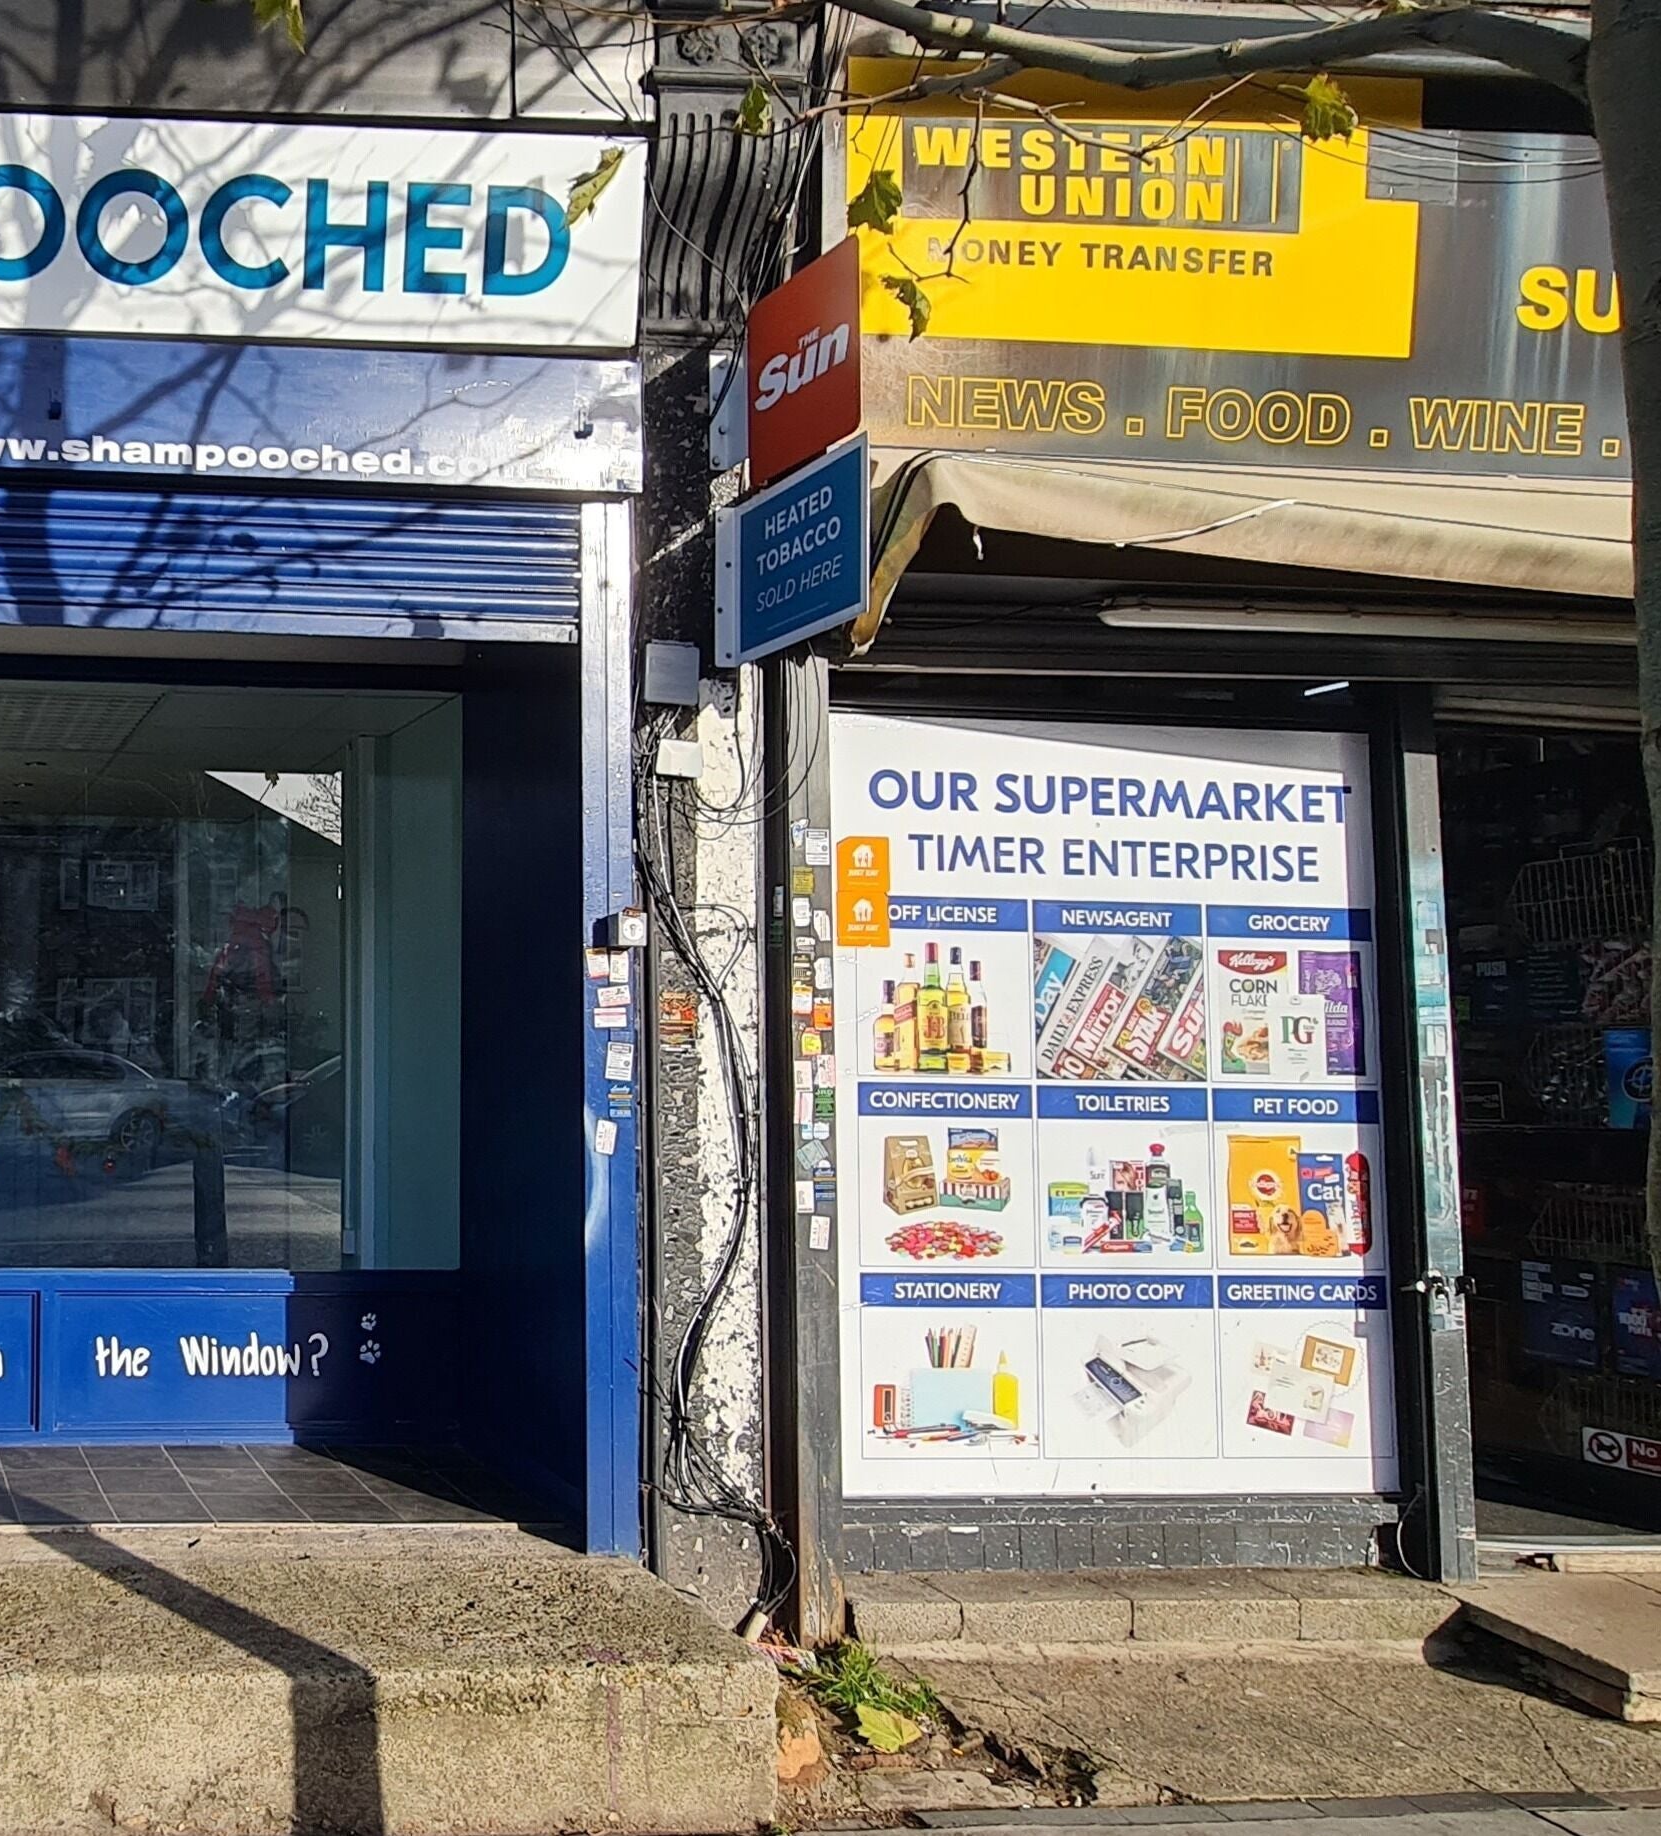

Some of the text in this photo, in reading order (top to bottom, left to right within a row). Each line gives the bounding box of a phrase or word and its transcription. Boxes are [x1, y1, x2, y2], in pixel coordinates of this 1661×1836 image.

[913, 125, 1226, 176] WESTERN
[1019, 174, 1225, 223] UNION
[927, 236, 1273, 277] MONEY TRANSFER
[797, 326, 820, 352] THE
[754, 321, 850, 412] Sun
[906, 374, 1107, 434] NEWS
[1166, 386, 1352, 447] FOOD
[1409, 396, 1586, 457] WINE
[764, 485, 833, 541] HEATED
[756, 515, 841, 576] TOBACCO
[756, 554, 843, 613] SOLD HERE
[869, 769, 1353, 824] OUR SUPERMARKET
[908, 833, 1321, 883] TIMER ENTERPRISE
[888, 903, 997, 924] OFF LICENSE
[1061, 908, 1173, 928] NEWSAGENT
[1247, 914, 1331, 933] GROCERY
[1229, 951, 1276, 970] Kellogg's
[1229, 978, 1278, 993] CORN
[1041, 955, 1103, 1061] DAILY EXPRESS
[1070, 988, 1125, 1060] Mirror
[1280, 1015, 1314, 1045] PG
[869, 1090, 1020, 1111] CONFECTIONERY
[1075, 1095, 1170, 1114] TOILETRIES
[1253, 1097, 1339, 1116] PET FOOD
[1307, 1182, 1343, 1201] Cat
[894, 1281, 1002, 1301] STATIONERY
[1068, 1282, 1185, 1302] PHOTO COPY
[1227, 1283, 1378, 1302] GREETING CARDS
[95, 1336, 150, 1378] the
[178, 1331, 330, 1379] Window?
[1631, 1440, 1659, 1459] No
